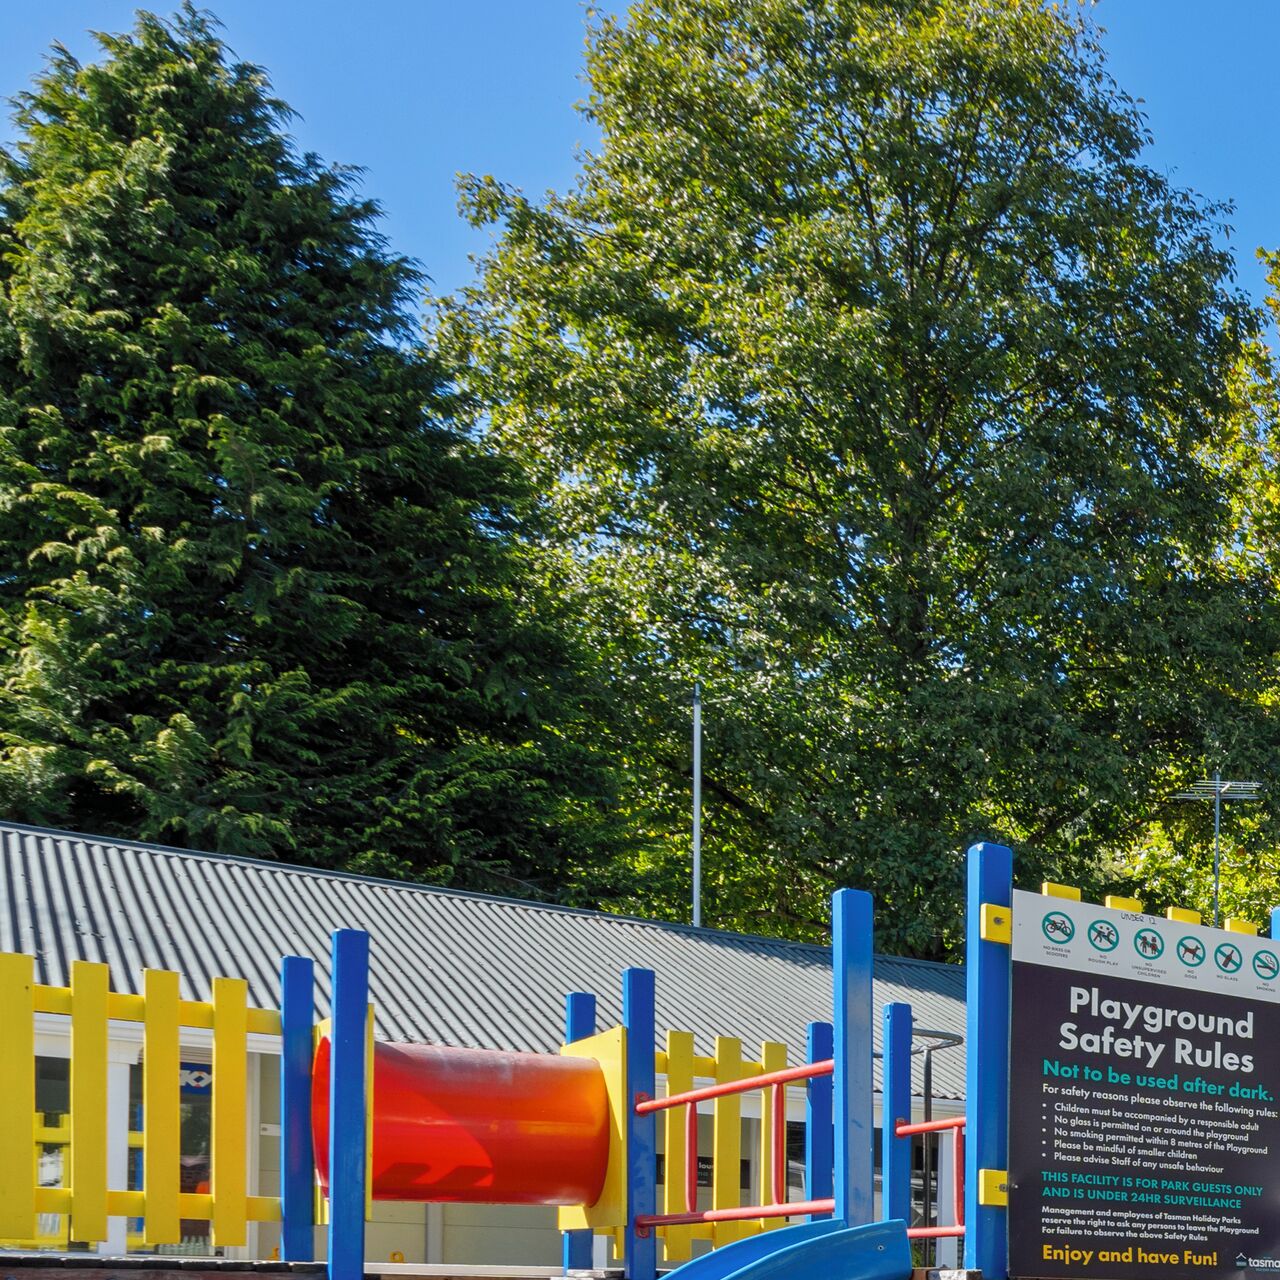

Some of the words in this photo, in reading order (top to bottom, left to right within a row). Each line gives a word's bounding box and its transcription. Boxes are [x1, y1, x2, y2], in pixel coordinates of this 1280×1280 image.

[1121, 912, 1144, 922] UNDER
[1070, 986, 1254, 1038] Playground
[1058, 1022, 1166, 1069] Safety
[1174, 1037, 1255, 1073] Rules
[1043, 1059, 1079, 1078] Not
[1084, 1066, 1102, 1081] to
[1108, 1066, 1131, 1084] be
[1136, 1074, 1178, 1090] used
[1183, 1077, 1225, 1095] after
[1229, 1082, 1274, 1101] dark.
[1043, 1083, 1059, 1093] For
[1061, 1086, 1090, 1099] safety
[1093, 1091, 1128, 1102] reasons
[1131, 1093, 1160, 1106] please
[1163, 1097, 1197, 1109] observe
[1200, 1101, 1212, 1111] the
[1215, 1102, 1254, 1117] following
[1256, 1108, 1278, 1118] rules:
[1055, 1103, 1090, 1114] Children
[1092, 1108, 1110, 1116] must
[1112, 1108, 1122, 1117] be
[1124, 1111, 1177, 1123] accompanied
[1179, 1115, 1189, 1125] by
[1197, 1119, 1239, 1129] responsible
[1241, 1122, 1259, 1131] adult
[1055, 1115, 1068, 1124] No
[1070, 1117, 1091, 1127] glass
[1093, 1119, 1100, 1127] is
[1101, 1121, 1139, 1131] permitted
[1164, 1127, 1191, 1136] around
[1193, 1128, 1204, 1137] the
[1206, 1130, 1249, 1141] playground
[1054, 1140, 1081, 1150] Please
[1083, 1142, 1094, 1151] be
[1096, 1144, 1125, 1153] mindful
[1138, 1148, 1165, 1157] smaller
[1167, 1150, 1197, 1160] children
[1055, 1128, 1068, 1136] No
[1070, 1130, 1104, 1141] smoking
[1106, 1134, 1144, 1143] permitted
[1146, 1137, 1168, 1145] within
[1178, 1141, 1202, 1149] metres
[1204, 1141, 1212, 1149] of
[1214, 1142, 1225, 1150] the
[1227, 1144, 1268, 1155] Playground
[1054, 1152, 1081, 1162] Please
[1083, 1154, 1110, 1164] advise
[1112, 1156, 1131, 1166] Staff
[1132, 1158, 1141, 1167] of
[1142, 1161, 1157, 1170] any
[1159, 1161, 1184, 1170] unsafe
[1186, 1163, 1224, 1173] behaviour
[1041, 1171, 1068, 1182] THIS
[1072, 1173, 1119, 1186] FACILITY
[1123, 1178, 1133, 1187] IS
[1136, 1178, 1158, 1189] FOR
[1161, 1180, 1189, 1191] PARK
[1192, 1182, 1232, 1194] GUESTS
[1235, 1185, 1263, 1196] ONLY
[1042, 1187, 1070, 1198] AND
[1074, 1189, 1084, 1199] IS
[1088, 1189, 1128, 1202] UNDER
[1131, 1192, 1161, 1203] 24HR
[1164, 1195, 1241, 1208] SURVEILLANCE
[1042, 1206, 1094, 1216] Management
[1096, 1209, 1111, 1217] and
[1113, 1210, 1153, 1220] employees
[1155, 1212, 1163, 1220] of
[1164, 1213, 1191, 1221] Tasman
[1193, 1214, 1220, 1224] Holiday
[1073, 1218, 1085, 1226] the
[1088, 1219, 1105, 1228] right
[1117, 1220, 1130, 1228] ask
[1132, 1222, 1146, 1230] any
[1148, 1223, 1176, 1231] persons
[1187, 1224, 1206, 1232] leave
[1220, 1226, 1259, 1235] Playground
[1057, 1227, 1082, 1235] failure
[1084, 1228, 1092, 1236] to
[1094, 1229, 1124, 1237] observe
[1126, 1230, 1137, 1238] the
[1139, 1231, 1162, 1239] above
[1164, 1232, 1187, 1241] Safety
[1043, 1244, 1093, 1265] Enjoy
[1098, 1247, 1133, 1262] and
[1138, 1247, 1179, 1264] have
[1183, 1251, 1217, 1266] Fun!
